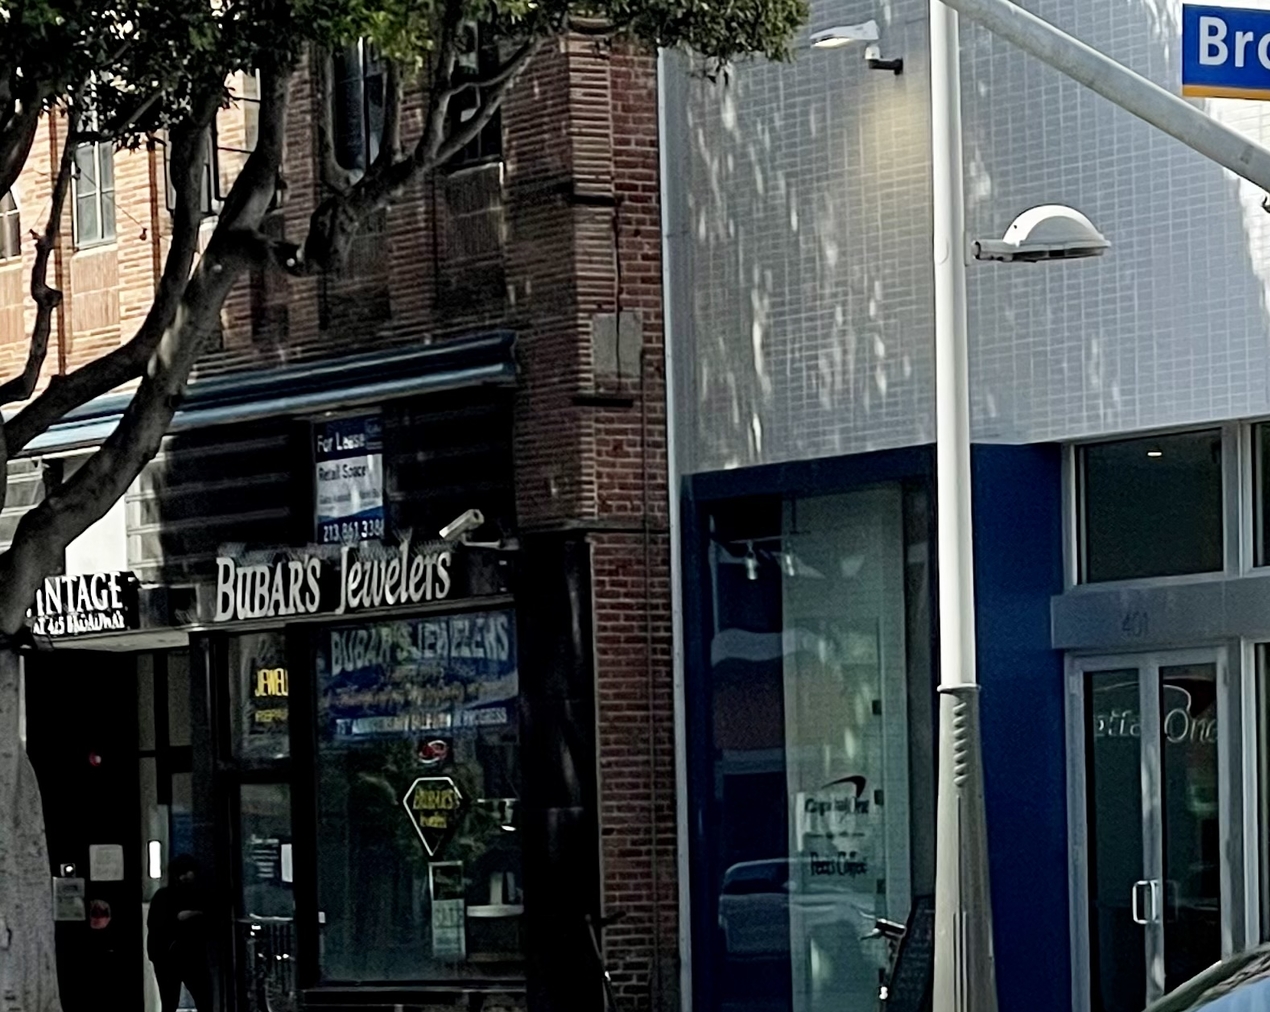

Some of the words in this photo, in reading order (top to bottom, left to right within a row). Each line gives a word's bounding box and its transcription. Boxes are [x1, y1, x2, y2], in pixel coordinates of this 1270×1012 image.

[317, 434, 333, 452] For
[27, 571, 123, 617] INTAGE
[213, 554, 321, 622] BUBAR'S
[335, 542, 451, 615] Jewelers
